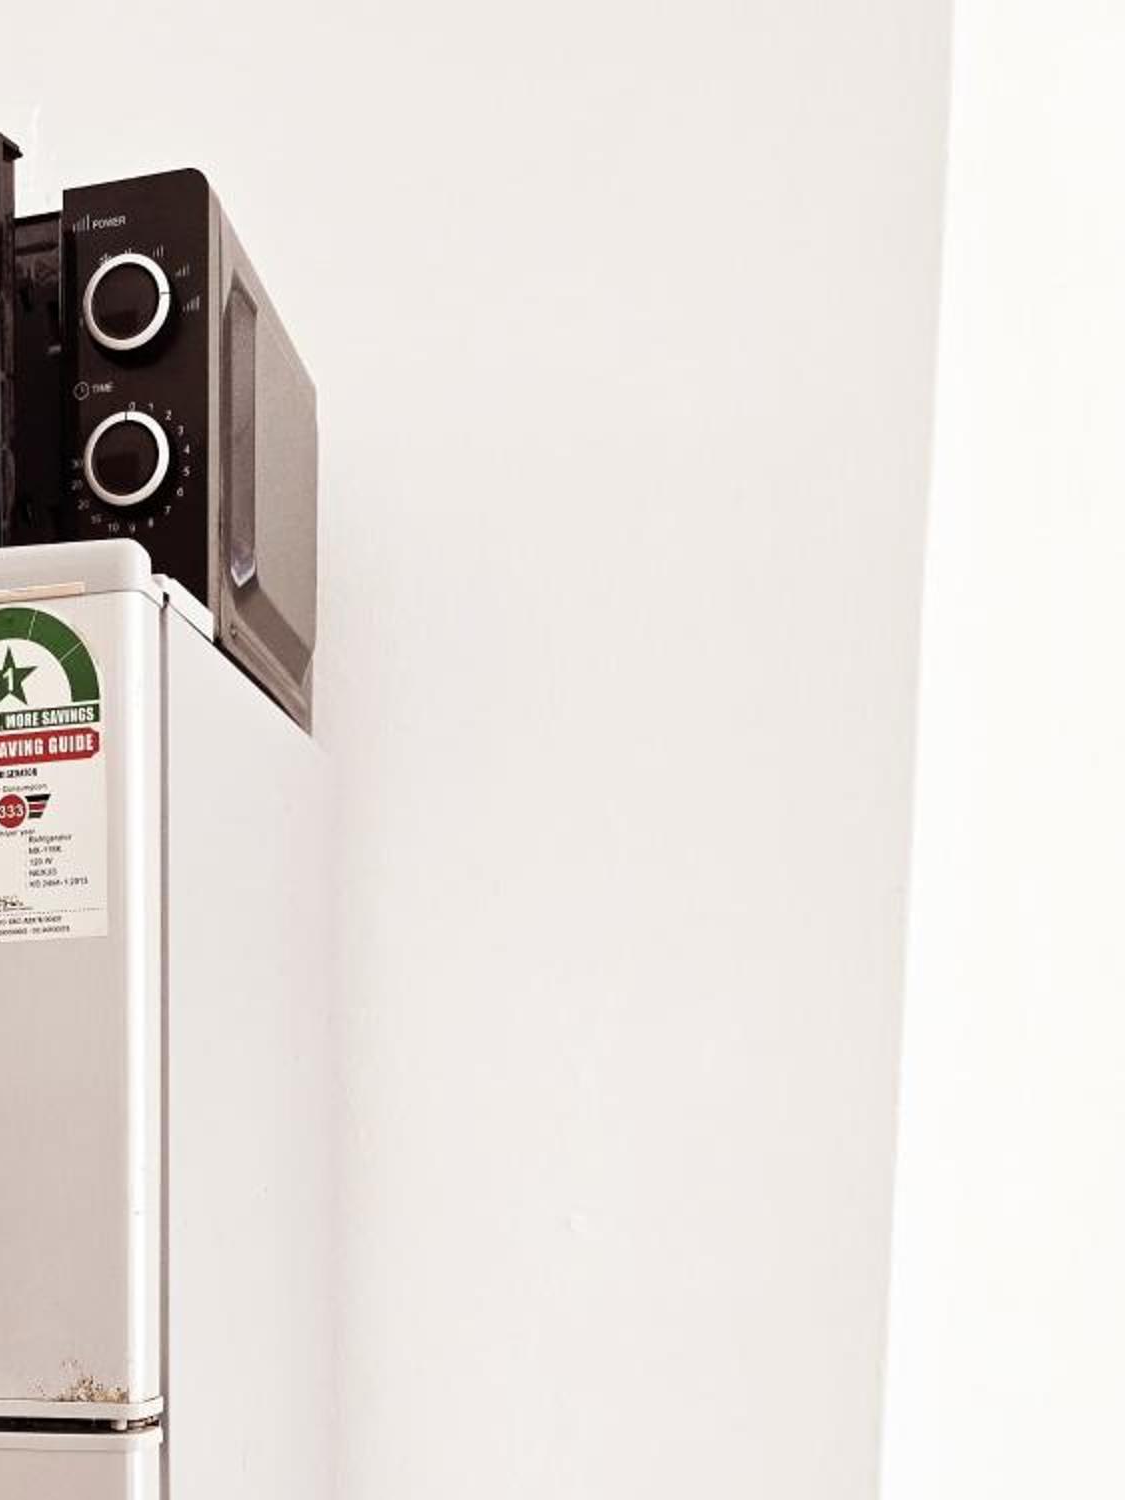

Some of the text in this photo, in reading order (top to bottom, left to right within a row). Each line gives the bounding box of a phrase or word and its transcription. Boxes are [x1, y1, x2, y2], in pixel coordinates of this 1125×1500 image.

[92, 215, 126, 230] POWER
[92, 382, 113, 393] TIME
[165, 409, 173, 421] 2
[177, 425, 184, 436] 3
[184, 444, 191, 454] 4
[182, 465, 191, 477] 5
[176, 487, 184, 497] 6
[165, 505, 172, 515] 7
[2, 667, 14, 692] 1
[5, 712, 39, 730] MORE
[42, 707, 94, 726] SAVINGS
[48, 733, 94, 755] GUIDE
